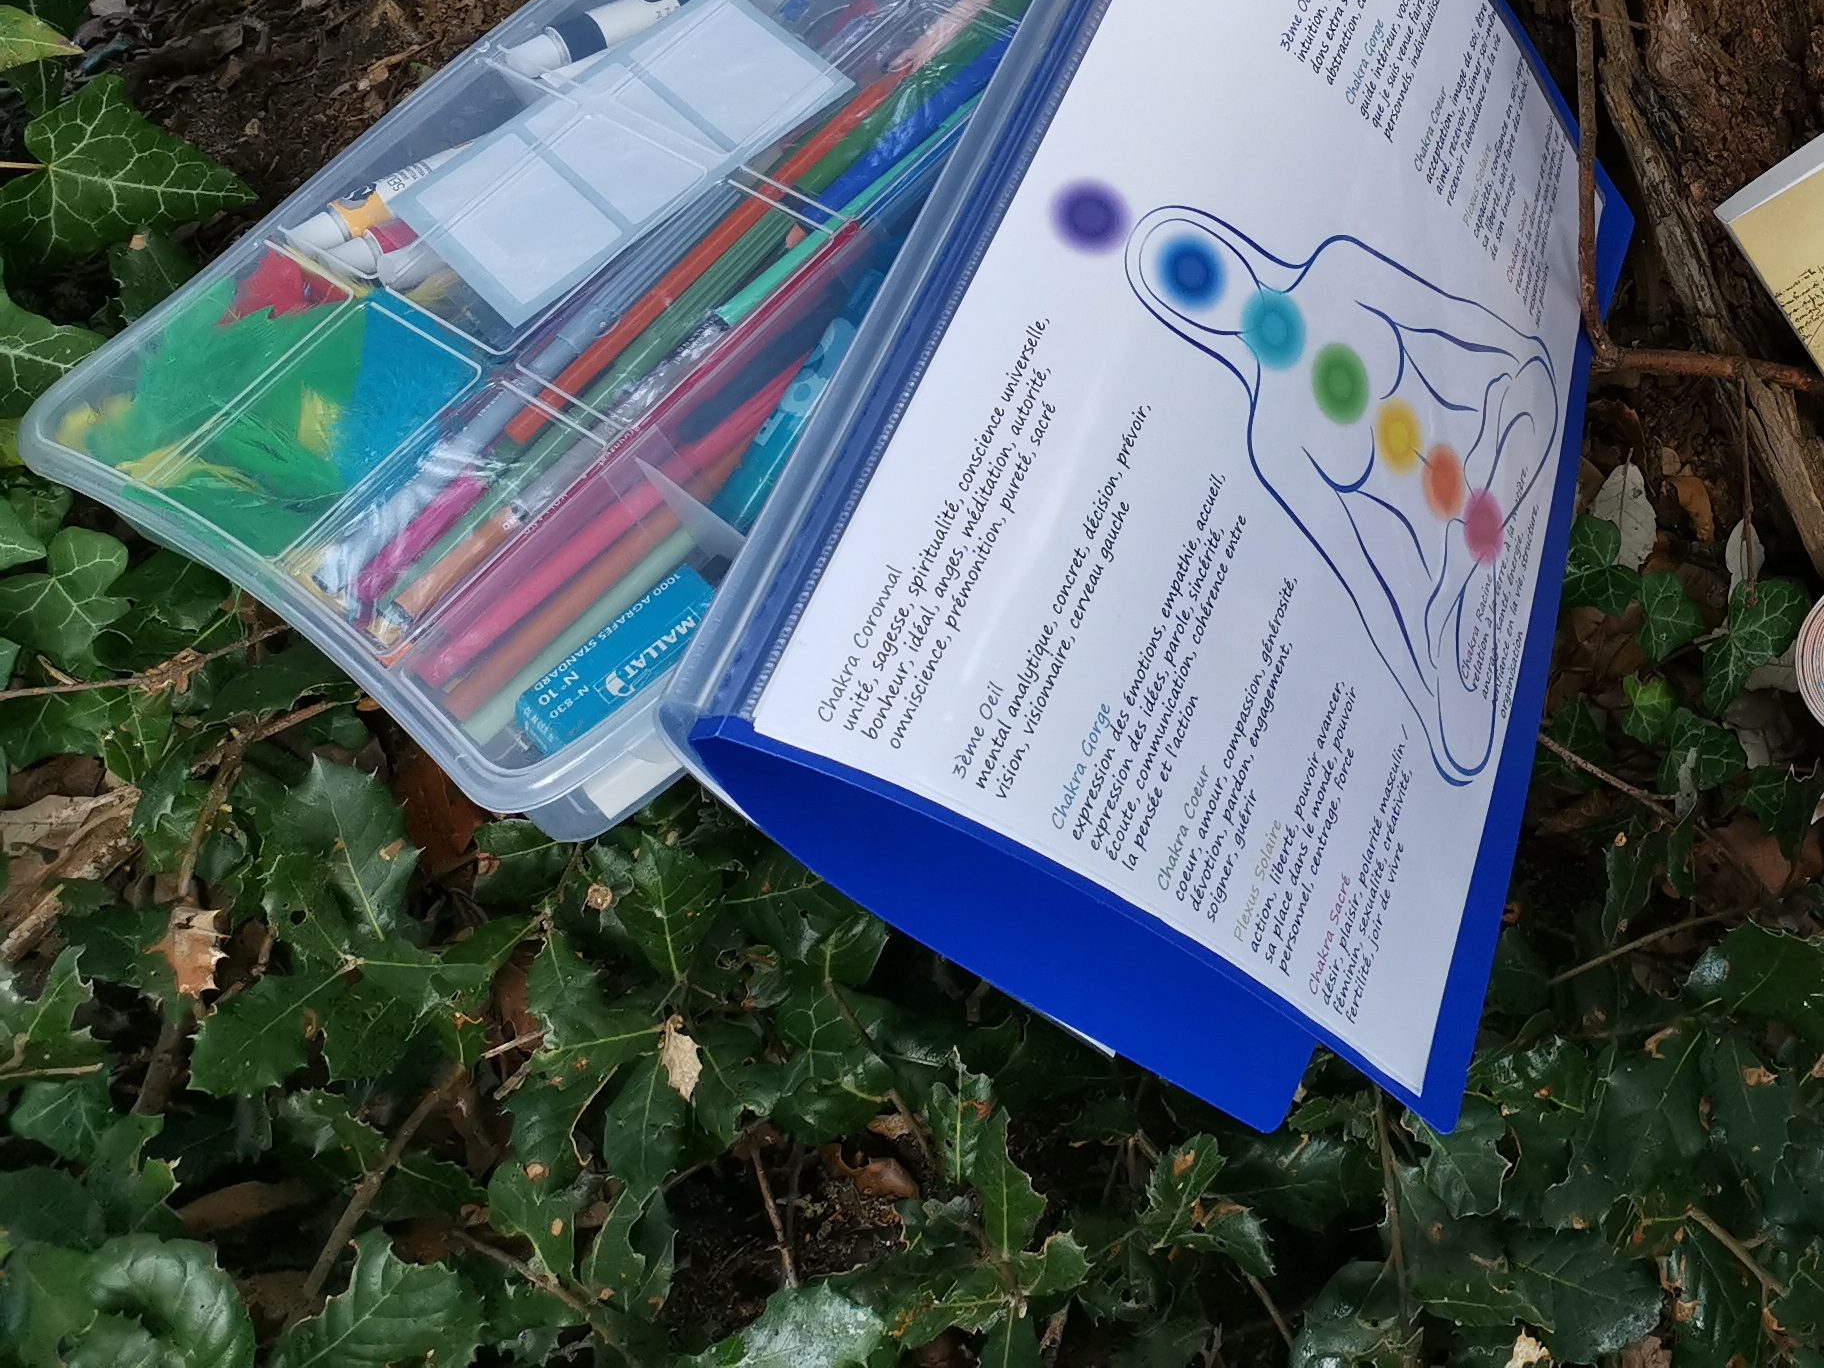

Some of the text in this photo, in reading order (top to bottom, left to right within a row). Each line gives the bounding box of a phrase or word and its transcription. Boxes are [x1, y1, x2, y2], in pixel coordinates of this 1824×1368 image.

[534, 573, 682, 691] 1000 AGRAFES STANDARD
[843, 318, 1050, 731] unité, sagesse, spiritualité, conscience universelle,
[860, 367, 1052, 740] bonheur, idéal, anges, méditation, autorité,
[890, 400, 1056, 750] omniscience, prémonition, pureté, sacré
[975, 405, 1152, 789] mental analytique, concret, décision, prévoir,
[538, 689, 559, 706] 10
[550, 700, 574, 719] 830
[623, 616, 697, 678] MALLAT
[817, 564, 903, 723] Chakra Coronnal
[952, 680, 1004, 779] 3ème Oeil
[995, 501, 1130, 799] vision, visionnaire, cerveau gauche
[1072, 473, 1226, 841] expression des émotions, empathie, accueil,
[1090, 528, 1225, 851] expression des idées, parole, sincérité,
[1105, 514, 1247, 861] écoute, communication, cohérence entre
[1175, 577, 1298, 902] coeur, amour, compassion, générosité,
[1051, 703, 1110, 830] Chakra Gorge
[1121, 696, 1199, 872] la pensée et l'action
[1157, 764, 1209, 891] Chakra Coeur
[1189, 642, 1293, 912] dévotion, pardon, engagement,
[1206, 788, 1257, 923] soigner, guérir
